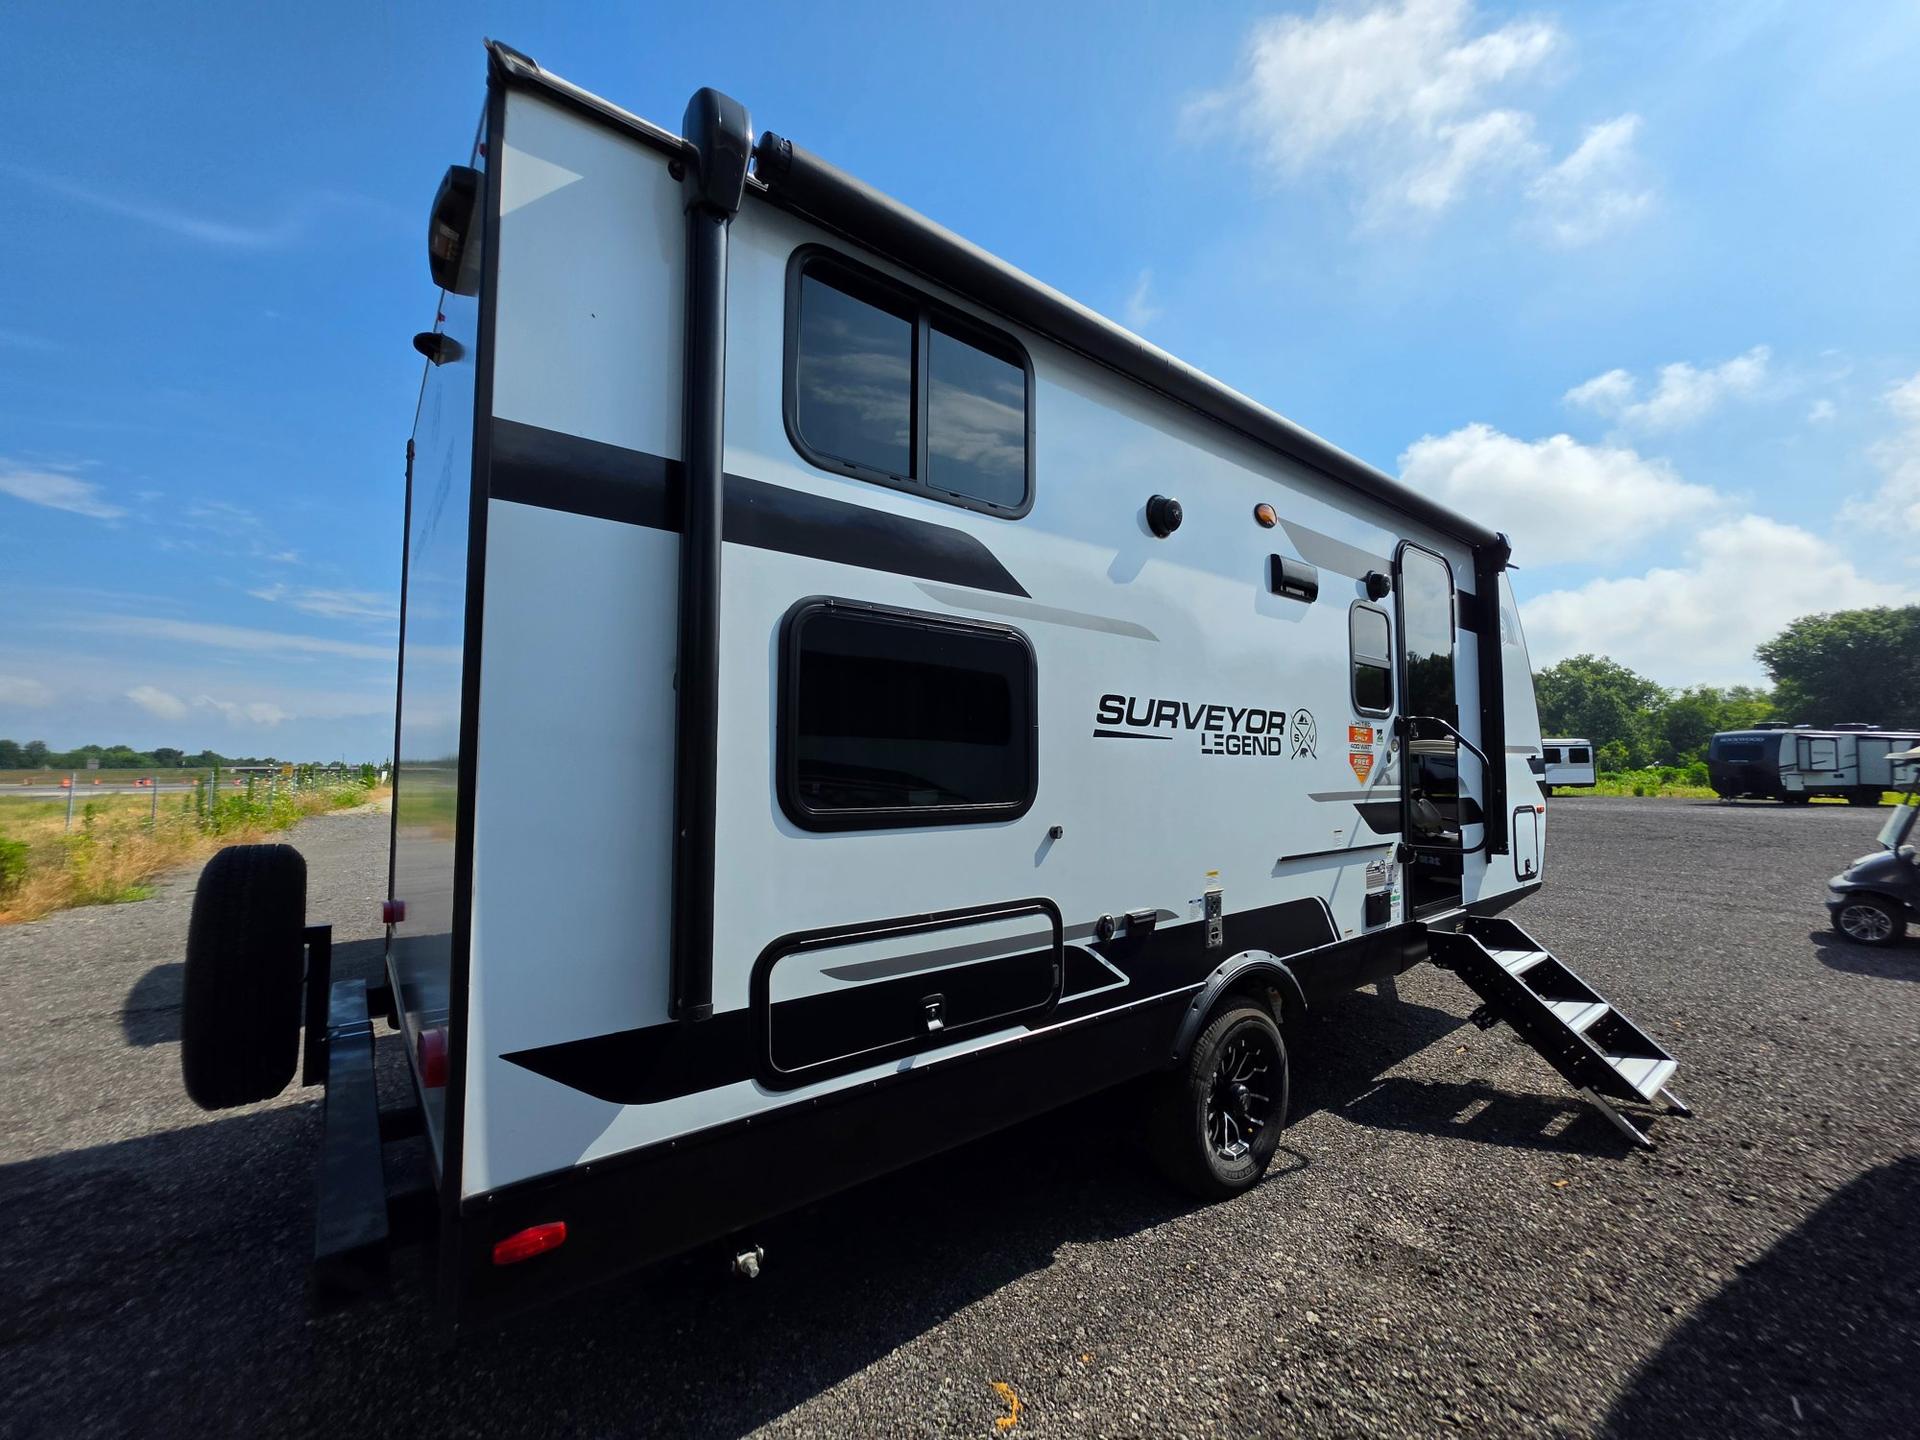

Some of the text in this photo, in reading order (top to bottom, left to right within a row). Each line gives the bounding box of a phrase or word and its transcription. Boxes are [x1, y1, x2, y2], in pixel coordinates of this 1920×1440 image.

[1096, 694, 1286, 734] SURVEYOR
[1201, 733, 1281, 756] LEGEND
[1294, 734, 1314, 742] S V
